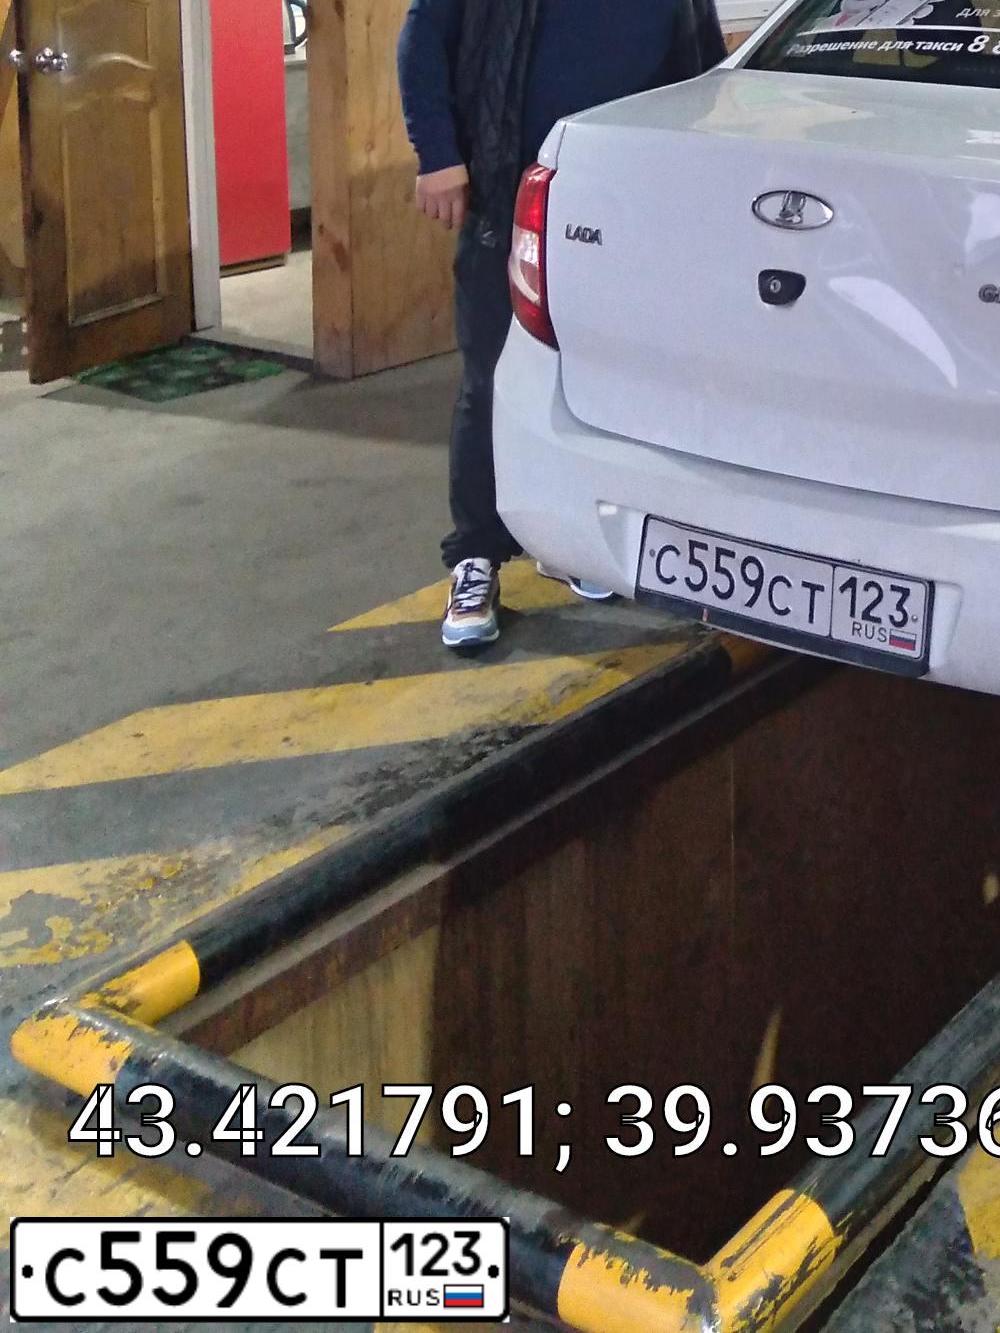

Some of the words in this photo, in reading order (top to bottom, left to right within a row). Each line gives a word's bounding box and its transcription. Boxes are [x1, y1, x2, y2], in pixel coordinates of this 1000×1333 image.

[957, 7, 989, 17] для
[786, 39, 878, 56] Разрешение
[878, 40, 914, 51] для
[915, 41, 963, 52] такси
[968, 34, 989, 53] 8
[565, 223, 603, 246] LADA
[655, 540, 825, 624] С559СТ
[839, 576, 911, 629] 123
[851, 621, 888, 644] RUS
